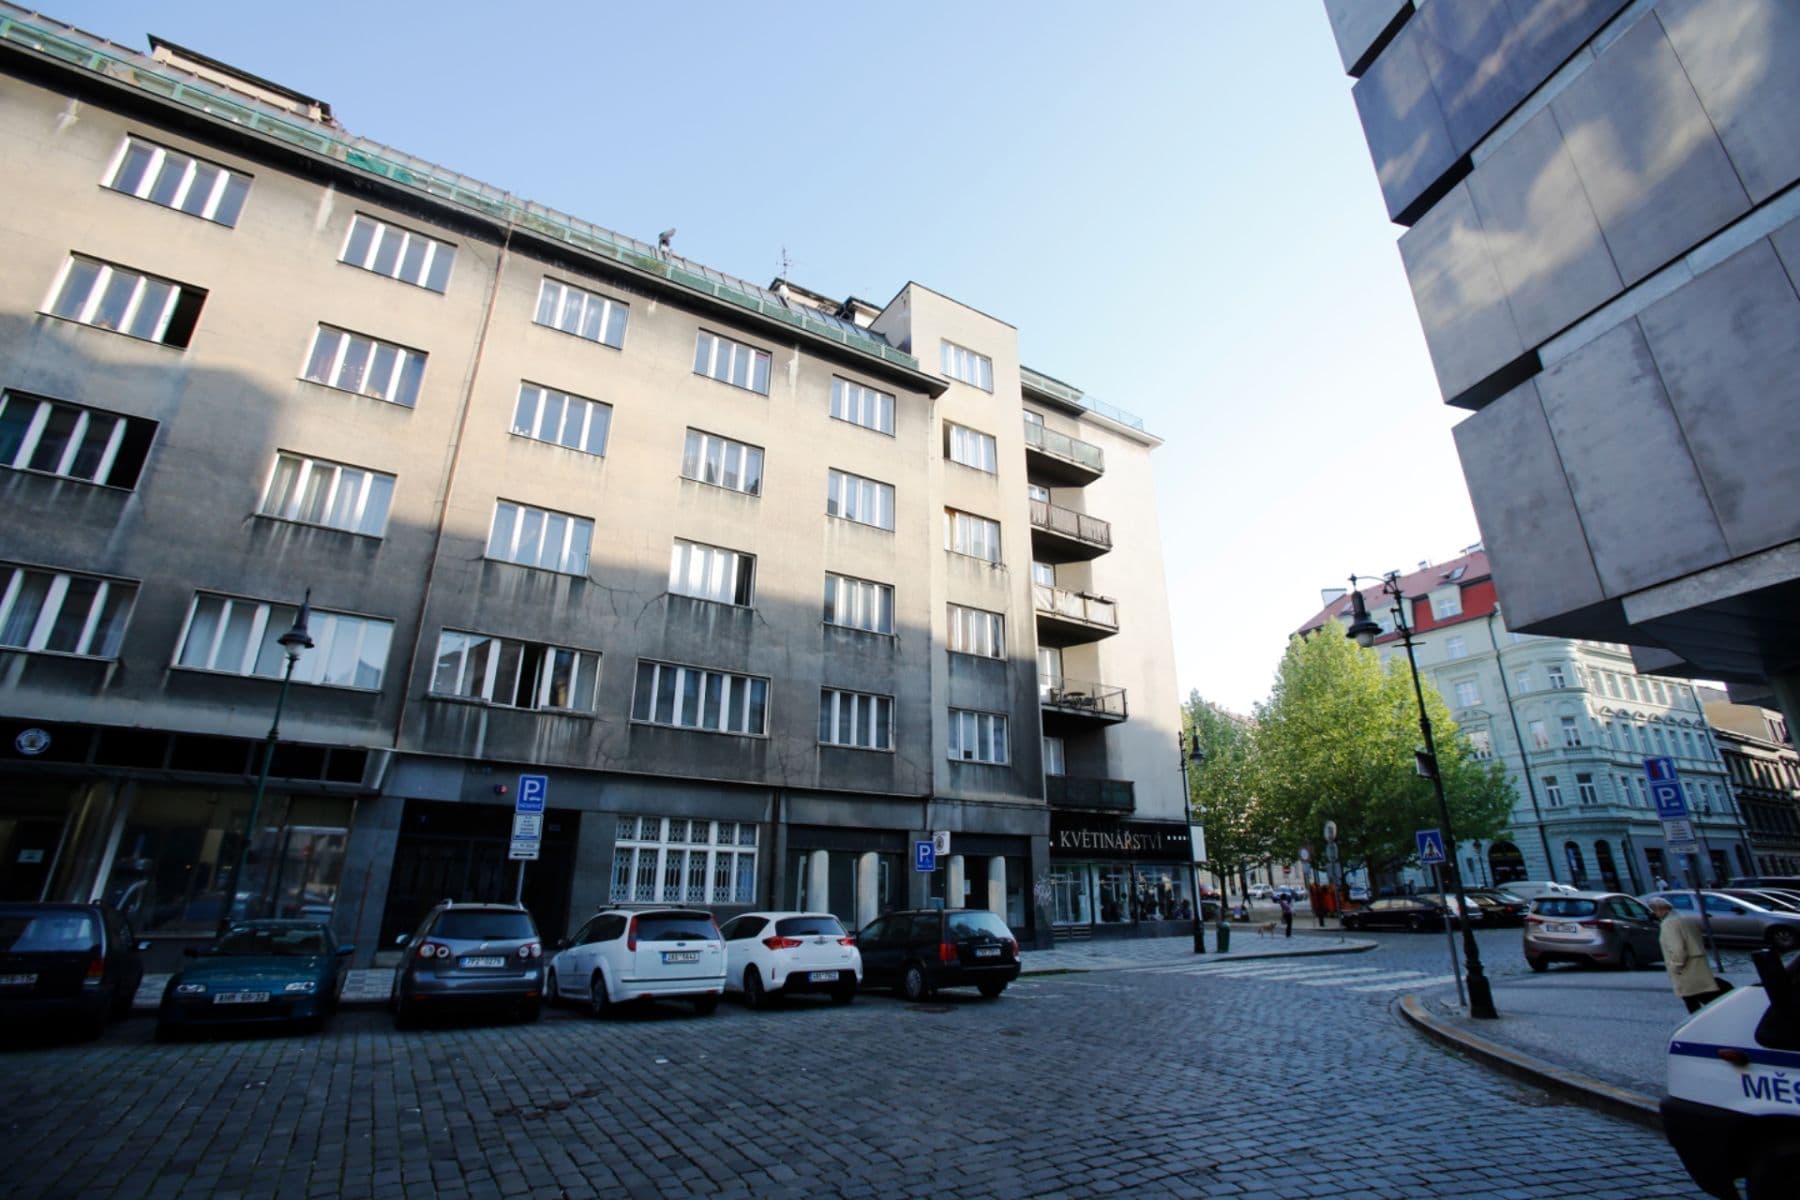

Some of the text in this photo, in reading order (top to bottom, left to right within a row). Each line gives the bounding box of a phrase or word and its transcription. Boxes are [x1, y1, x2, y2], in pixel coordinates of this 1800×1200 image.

[523, 779, 540, 801] P
[1659, 787, 1677, 808] P
[1060, 828, 1162, 850] KVĚTINÁŘSTVÍ
[919, 845, 931, 863] P
